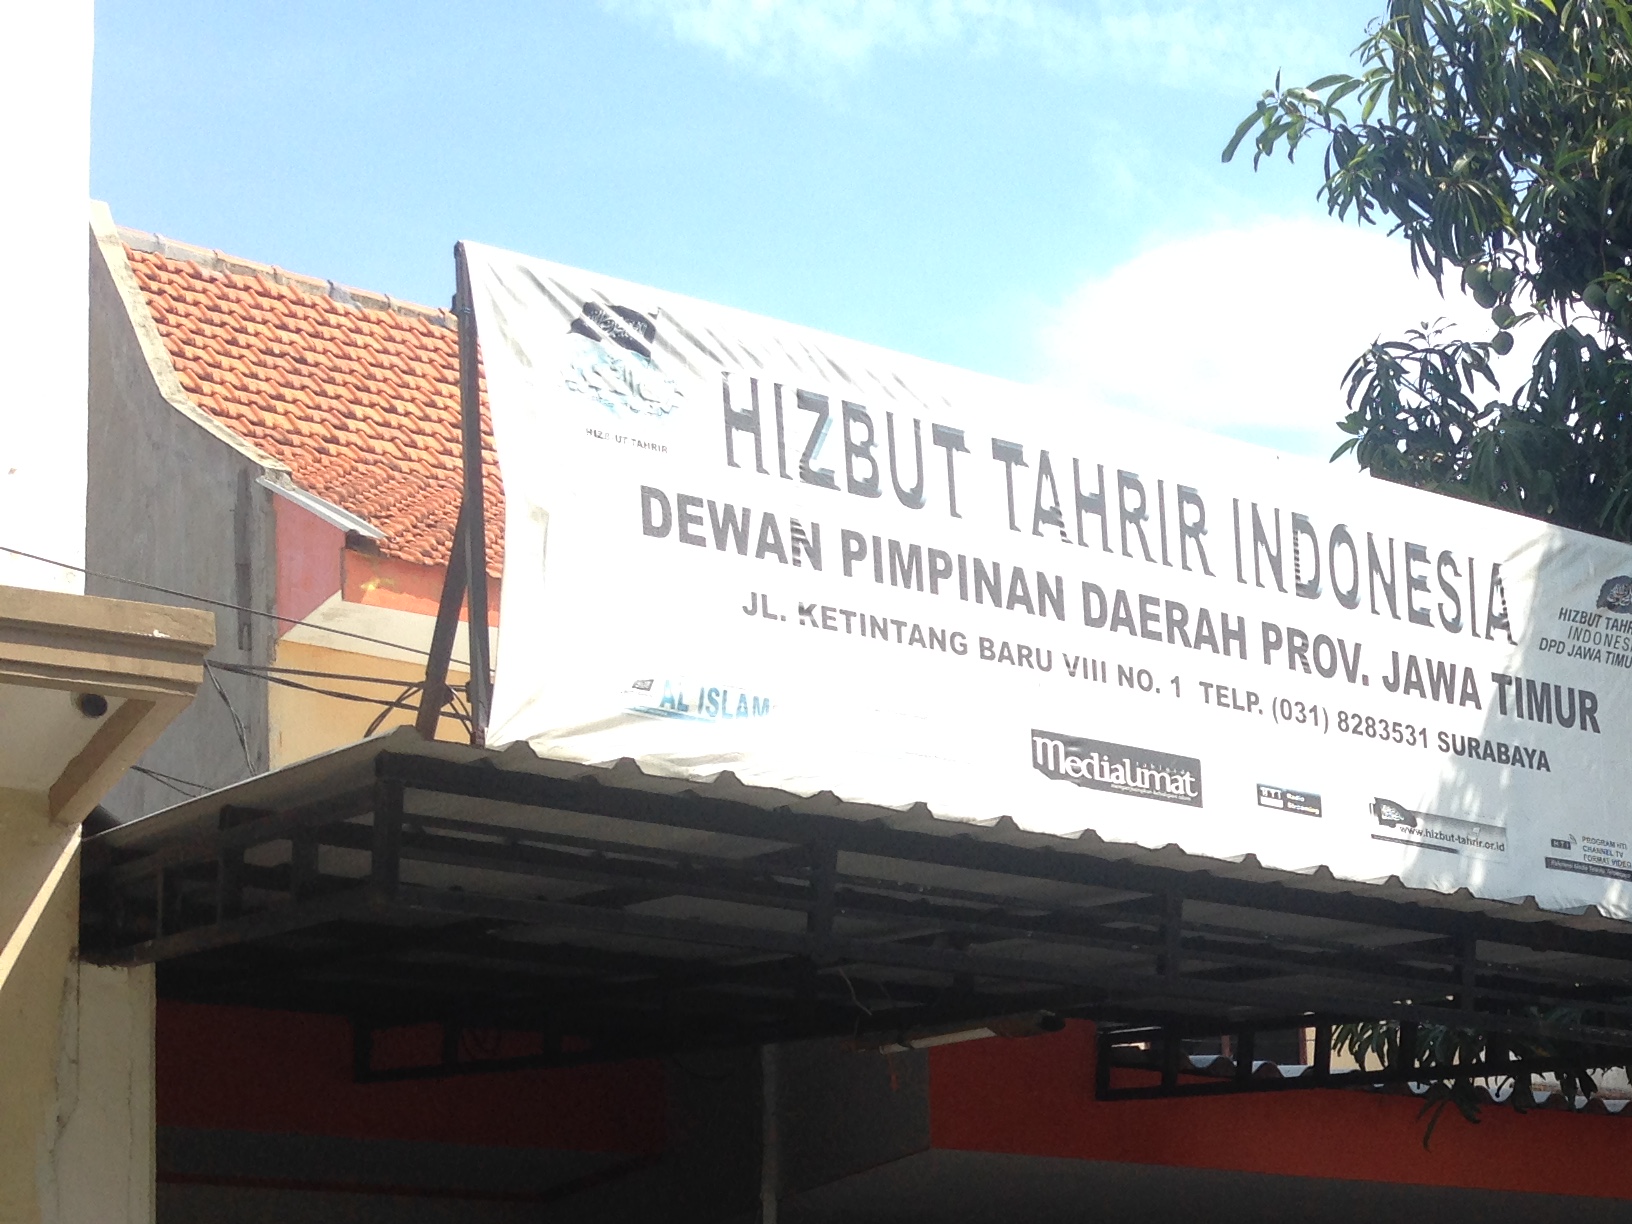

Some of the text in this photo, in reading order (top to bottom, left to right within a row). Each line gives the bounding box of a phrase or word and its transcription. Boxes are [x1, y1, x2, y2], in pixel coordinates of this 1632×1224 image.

[722, 371, 971, 519] HIZBUT
[991, 438, 1216, 578] TAHRIR
[1232, 498, 1518, 647] INDONESIA
[640, 485, 1600, 733] DEWAN PIMPINAN DAERAH PROV. JAWA TIMUR
[1539, 637, 1566, 655] DPD
[1568, 644, 1601, 663] JAWA
[1558, 607, 1602, 628] HIZBUT
[659, 680, 770, 719] AL ISLAM
[743, 592, 1551, 772] JL. KETINTANG BARU VIII NO. 1 TELP. (031) 8283531 SURABAYA
